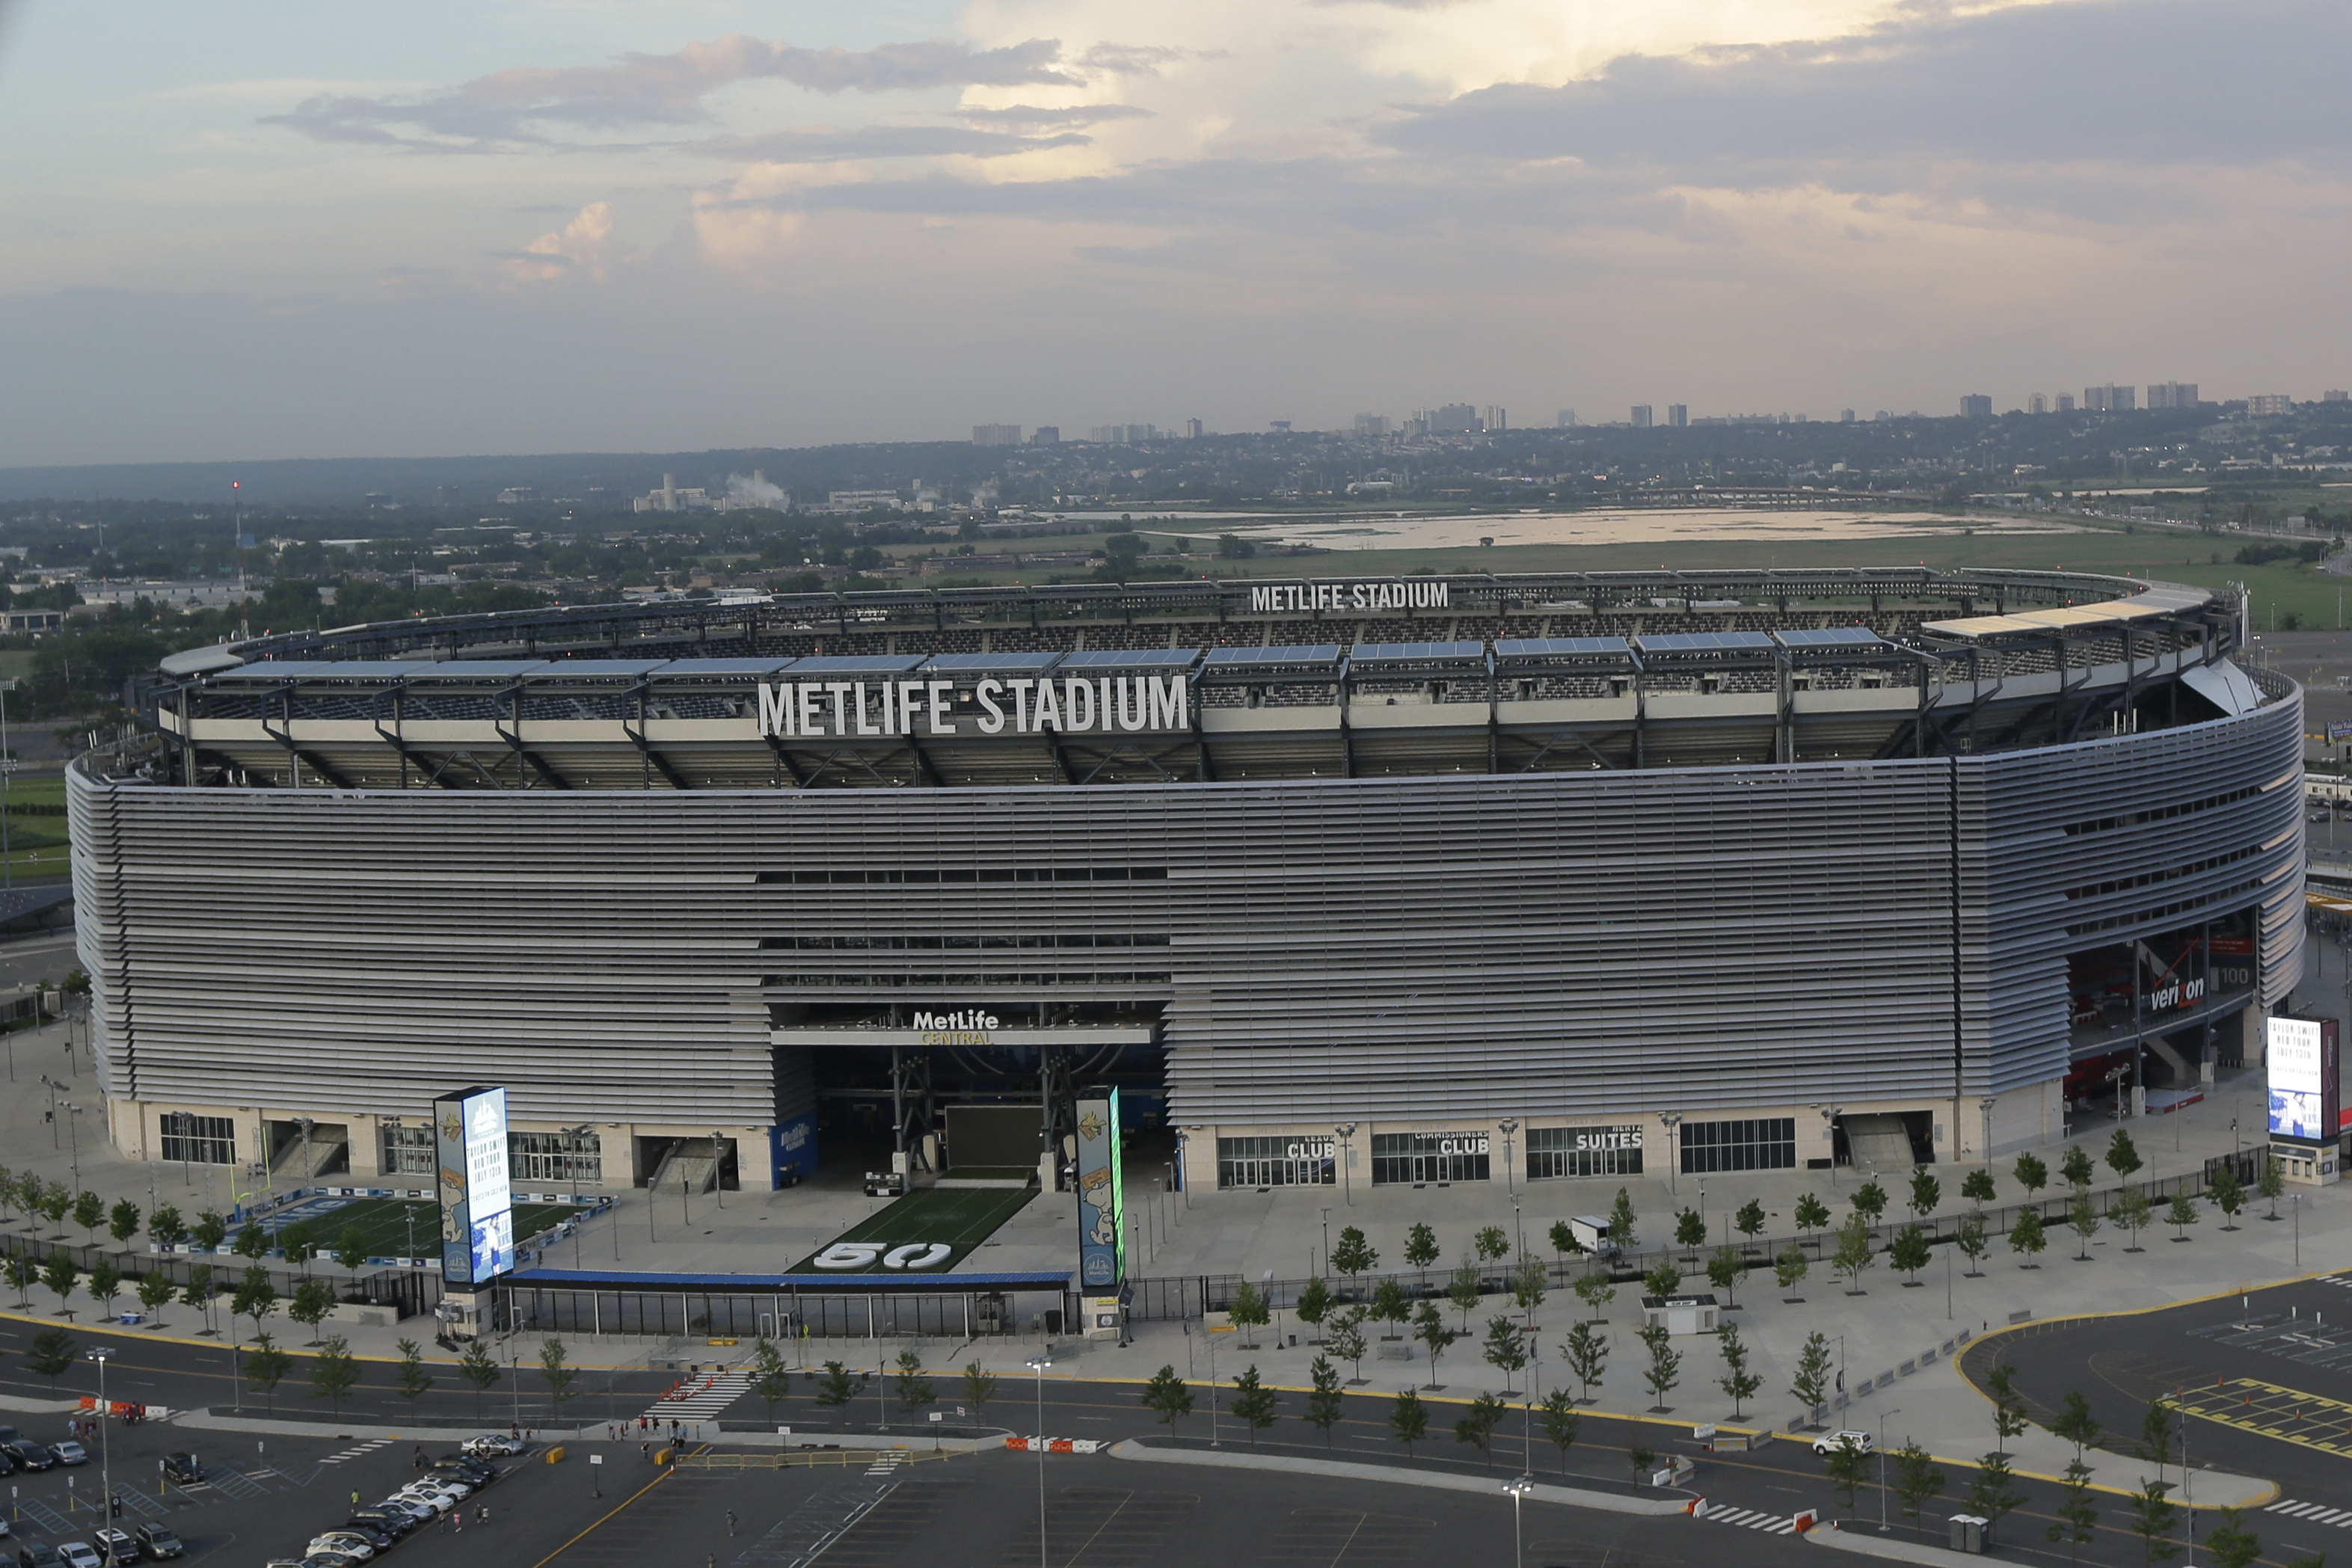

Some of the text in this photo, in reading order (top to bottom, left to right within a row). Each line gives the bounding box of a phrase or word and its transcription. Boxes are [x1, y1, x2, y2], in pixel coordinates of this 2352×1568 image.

[1252, 582, 1449, 611] METLIFE STADIUM
[758, 675, 1188, 736] METLIFE STADIUM
[2151, 977, 2204, 1010] verizon
[912, 1009, 999, 1030] MetLife
[920, 1031, 993, 1045] CENTRAL
[1415, 1131, 1489, 1140] COMMISSIONERS
[1612, 1125, 1642, 1133] HERTZ
[1440, 1139, 1490, 1155] CLUB
[1576, 1132, 1642, 1150] SUITES
[1287, 1143, 1336, 1159] CLUB
[814, 1242, 952, 1270] 50
